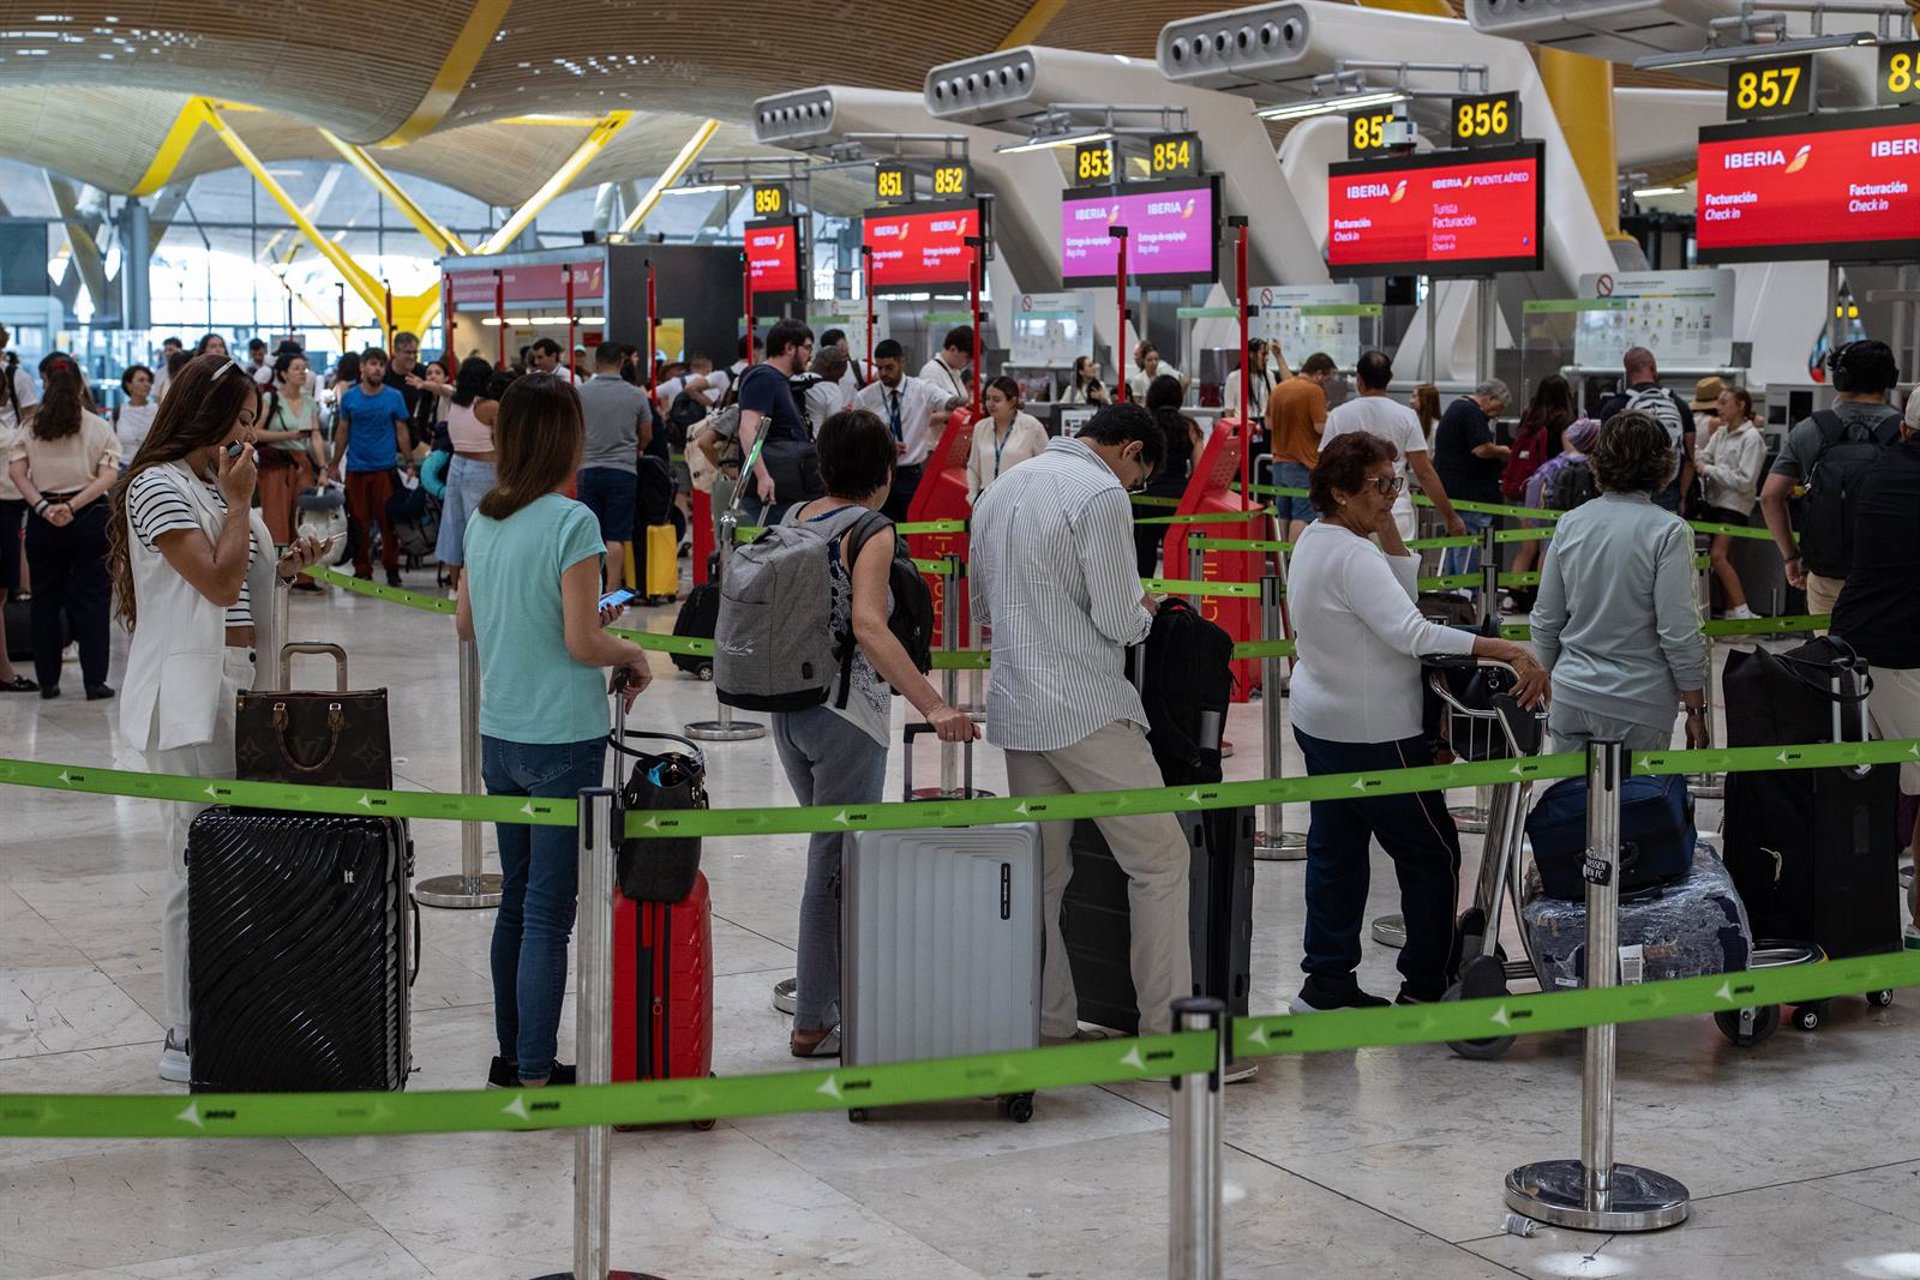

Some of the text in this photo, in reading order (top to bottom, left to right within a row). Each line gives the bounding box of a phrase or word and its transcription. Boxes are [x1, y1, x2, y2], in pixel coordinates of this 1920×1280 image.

[1737, 67, 1801, 110] 857
[1458, 100, 1508, 138] 856
[1354, 114, 1395, 149] 85
[1079, 149, 1113, 178] 853
[1153, 140, 1190, 171] 854
[1725, 150, 1786, 169] IBERIA
[878, 171, 903, 196] 851
[935, 167, 963, 193] 852
[1432, 178, 1462, 189] IBERIA
[1849, 181, 1907, 196] Facturación
[755, 188, 780, 212] 850
[1346, 183, 1390, 199] IBERIA
[1705, 191, 1757, 205] Facturación
[1075, 207, 1108, 220] IBERIA
[1147, 201, 1182, 215] IBERIA
[1849, 199, 1878, 212] Check
